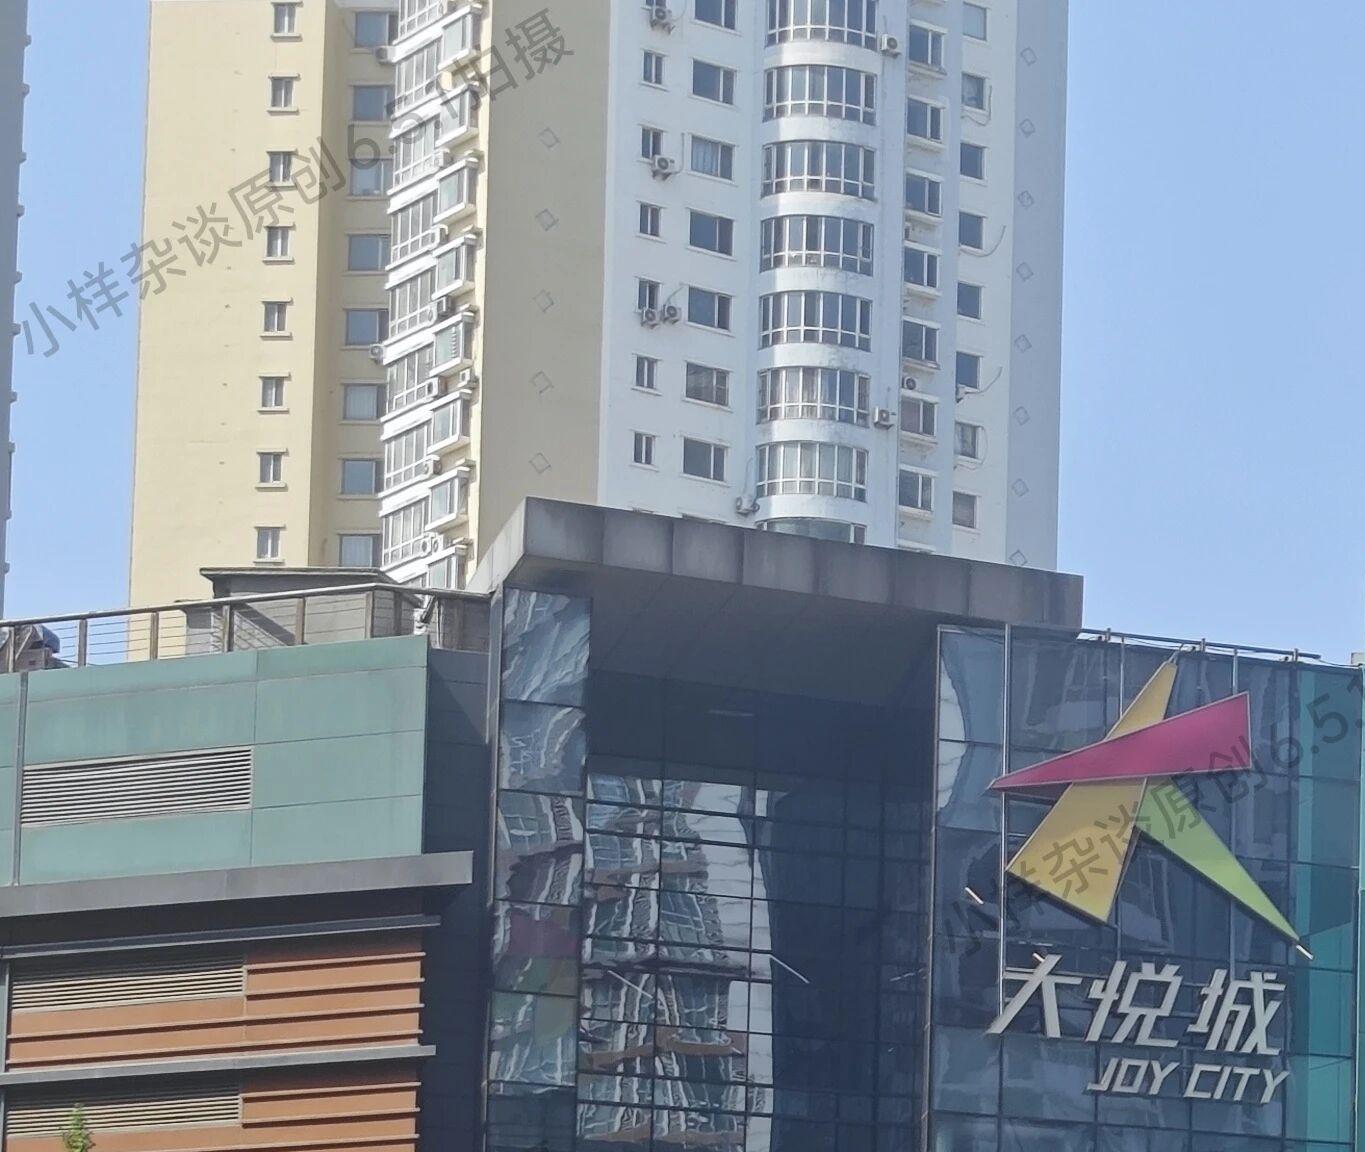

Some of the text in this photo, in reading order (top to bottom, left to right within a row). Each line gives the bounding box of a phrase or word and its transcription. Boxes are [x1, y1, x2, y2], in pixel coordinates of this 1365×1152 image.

[989, 955, 1285, 1054] 大悦城
[1088, 1059, 1289, 1104] JOY CITY
